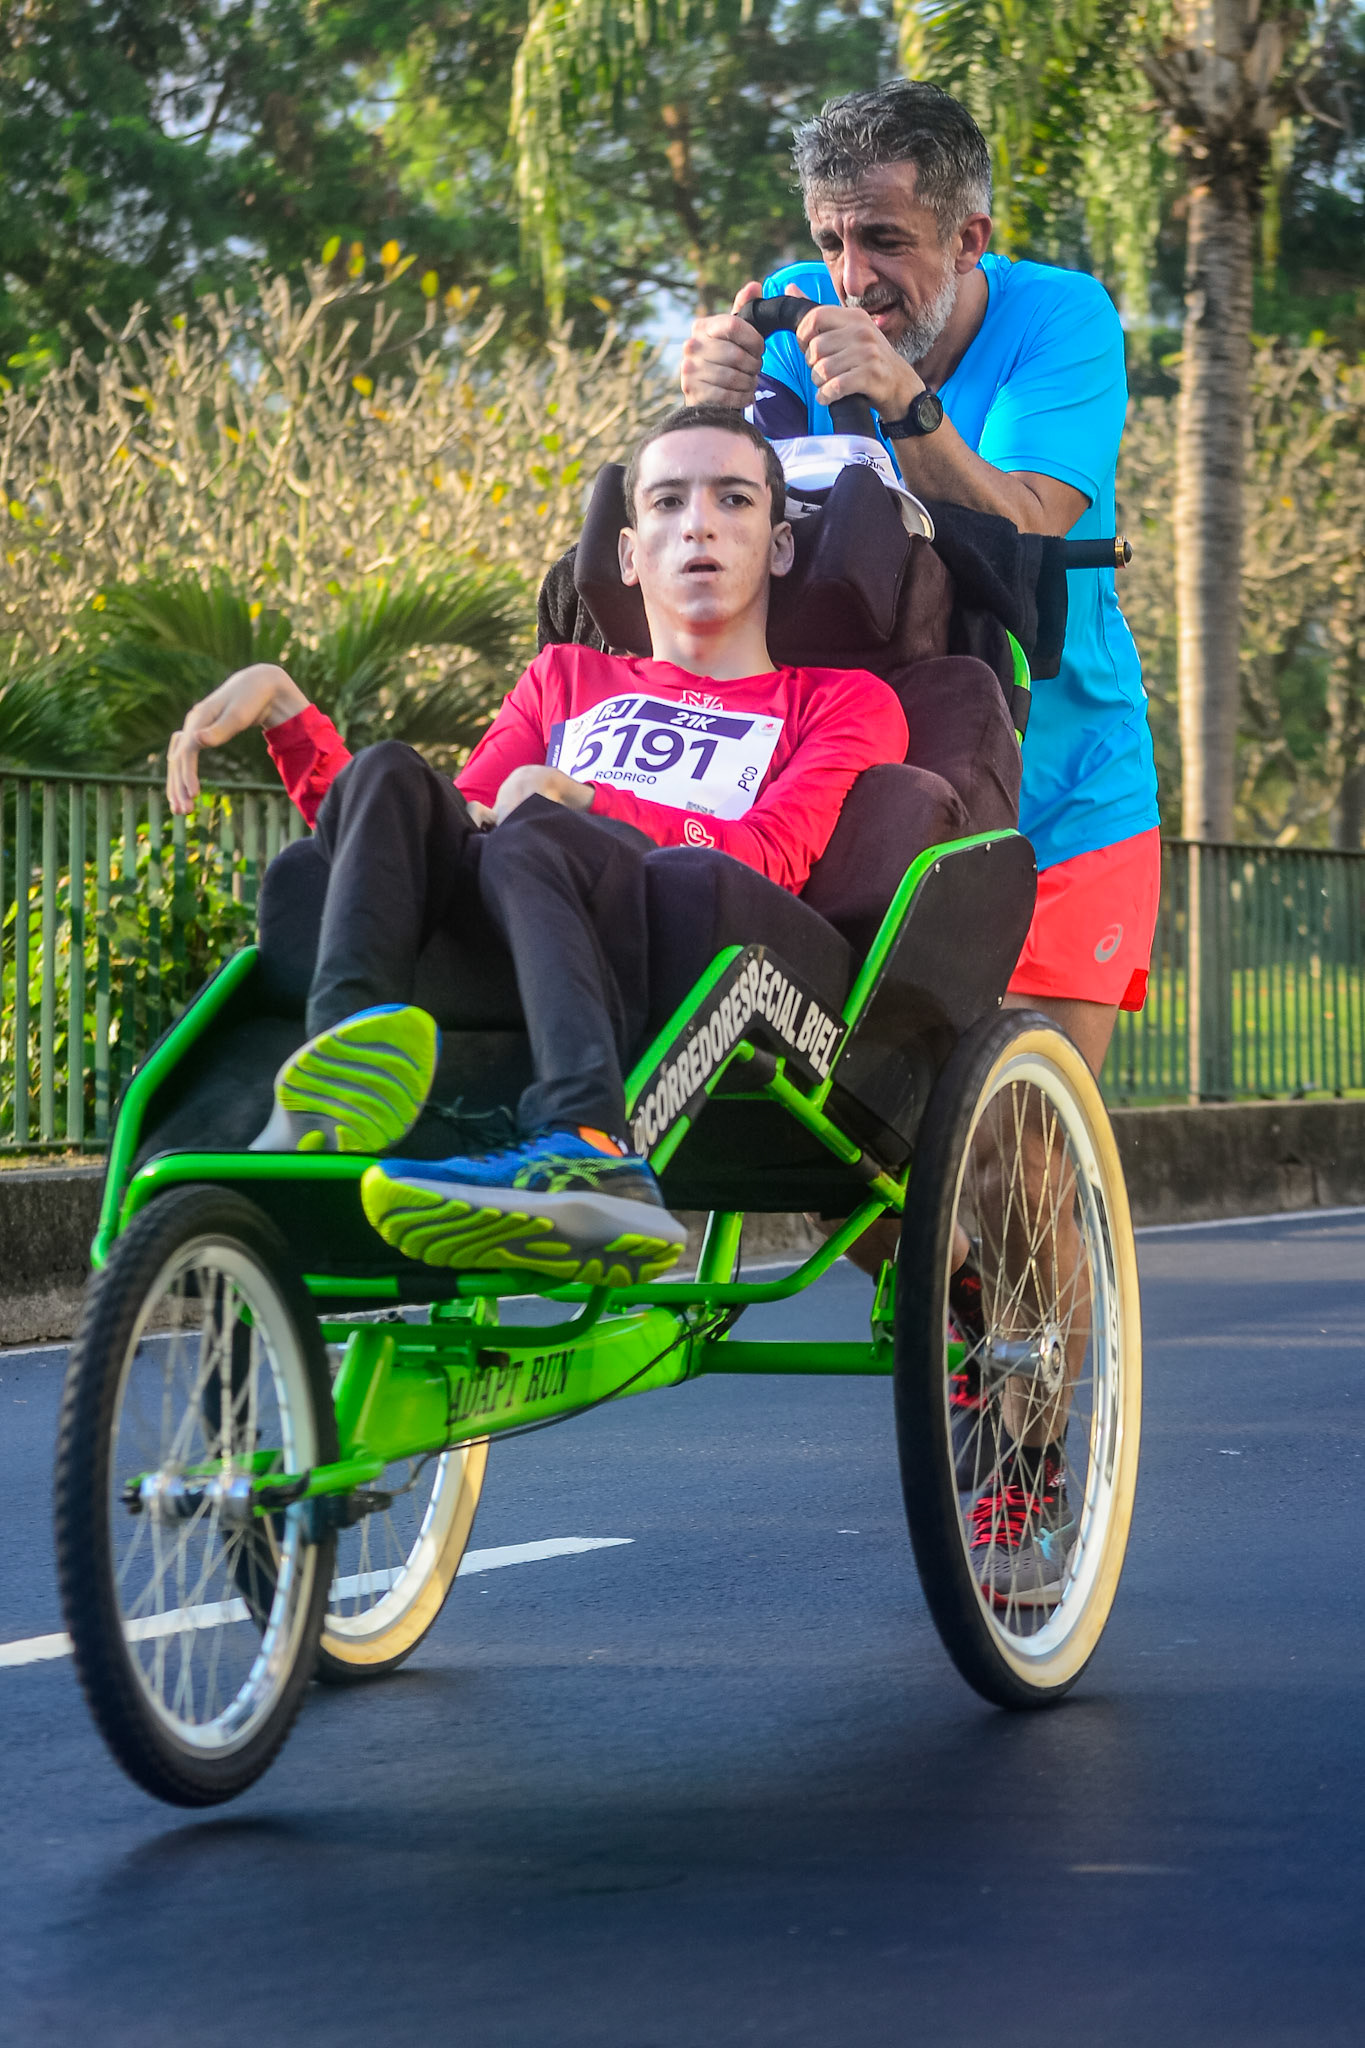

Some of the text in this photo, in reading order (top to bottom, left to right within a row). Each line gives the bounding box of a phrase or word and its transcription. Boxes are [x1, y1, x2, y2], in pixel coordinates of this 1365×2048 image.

[598, 700, 717, 731] RJ 21K
[570, 724, 719, 780] 5191
[594, 770, 657, 785] RODRIGO
[738, 766, 758, 792] PCD
[796, 1000, 839, 1080] BIEL
[445, 1348, 575, 1426] ADAPT RUN
